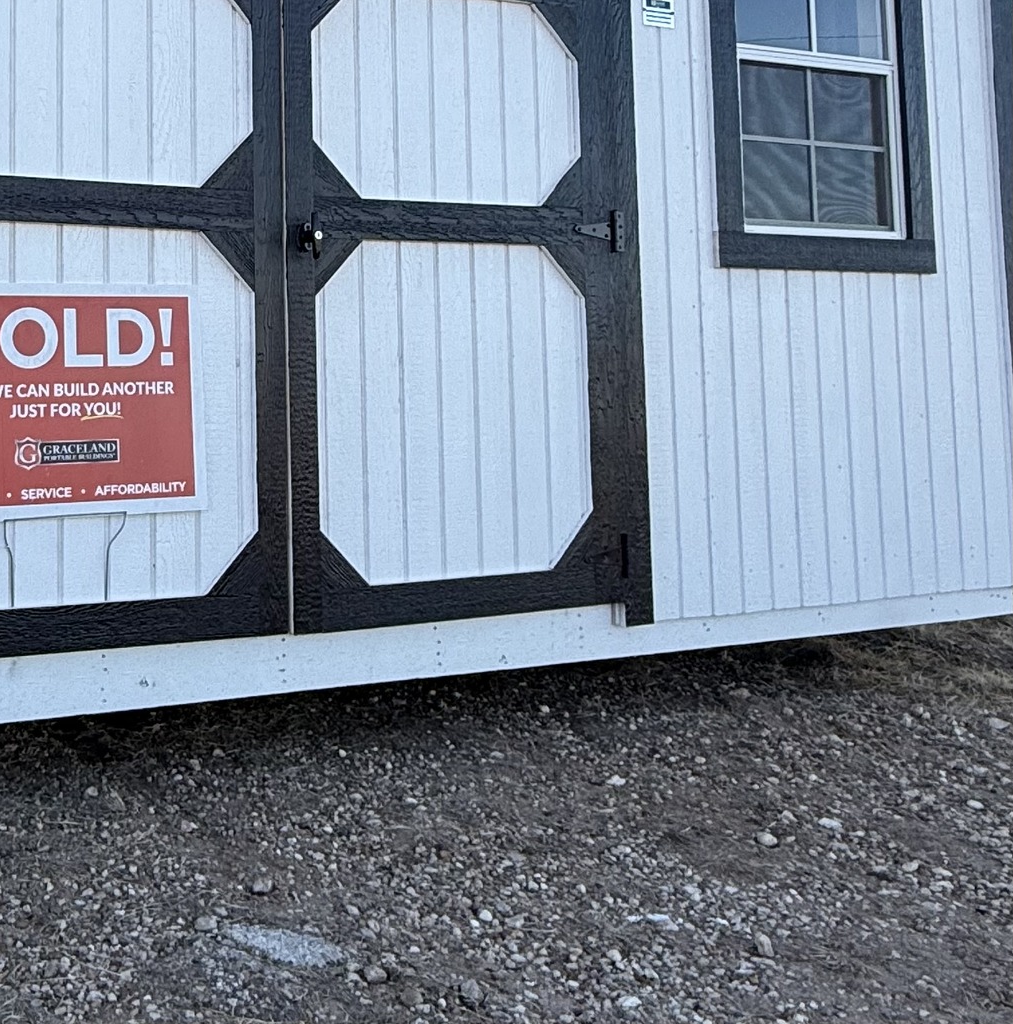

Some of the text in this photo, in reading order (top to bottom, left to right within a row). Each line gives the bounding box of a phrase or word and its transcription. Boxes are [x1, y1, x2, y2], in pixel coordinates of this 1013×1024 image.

[16, 383, 50, 398] CAN
[53, 382, 100, 397] BUILD
[102, 381, 175, 396] ANOTHER
[9, 402, 121, 419] JUST FOR YOU!
[19, 443, 38, 464] G
[42, 442, 116, 455] GRACELAND
[21, 487, 72, 500] SERVICE
[94, 481, 187, 496] AFFORDABILITY
